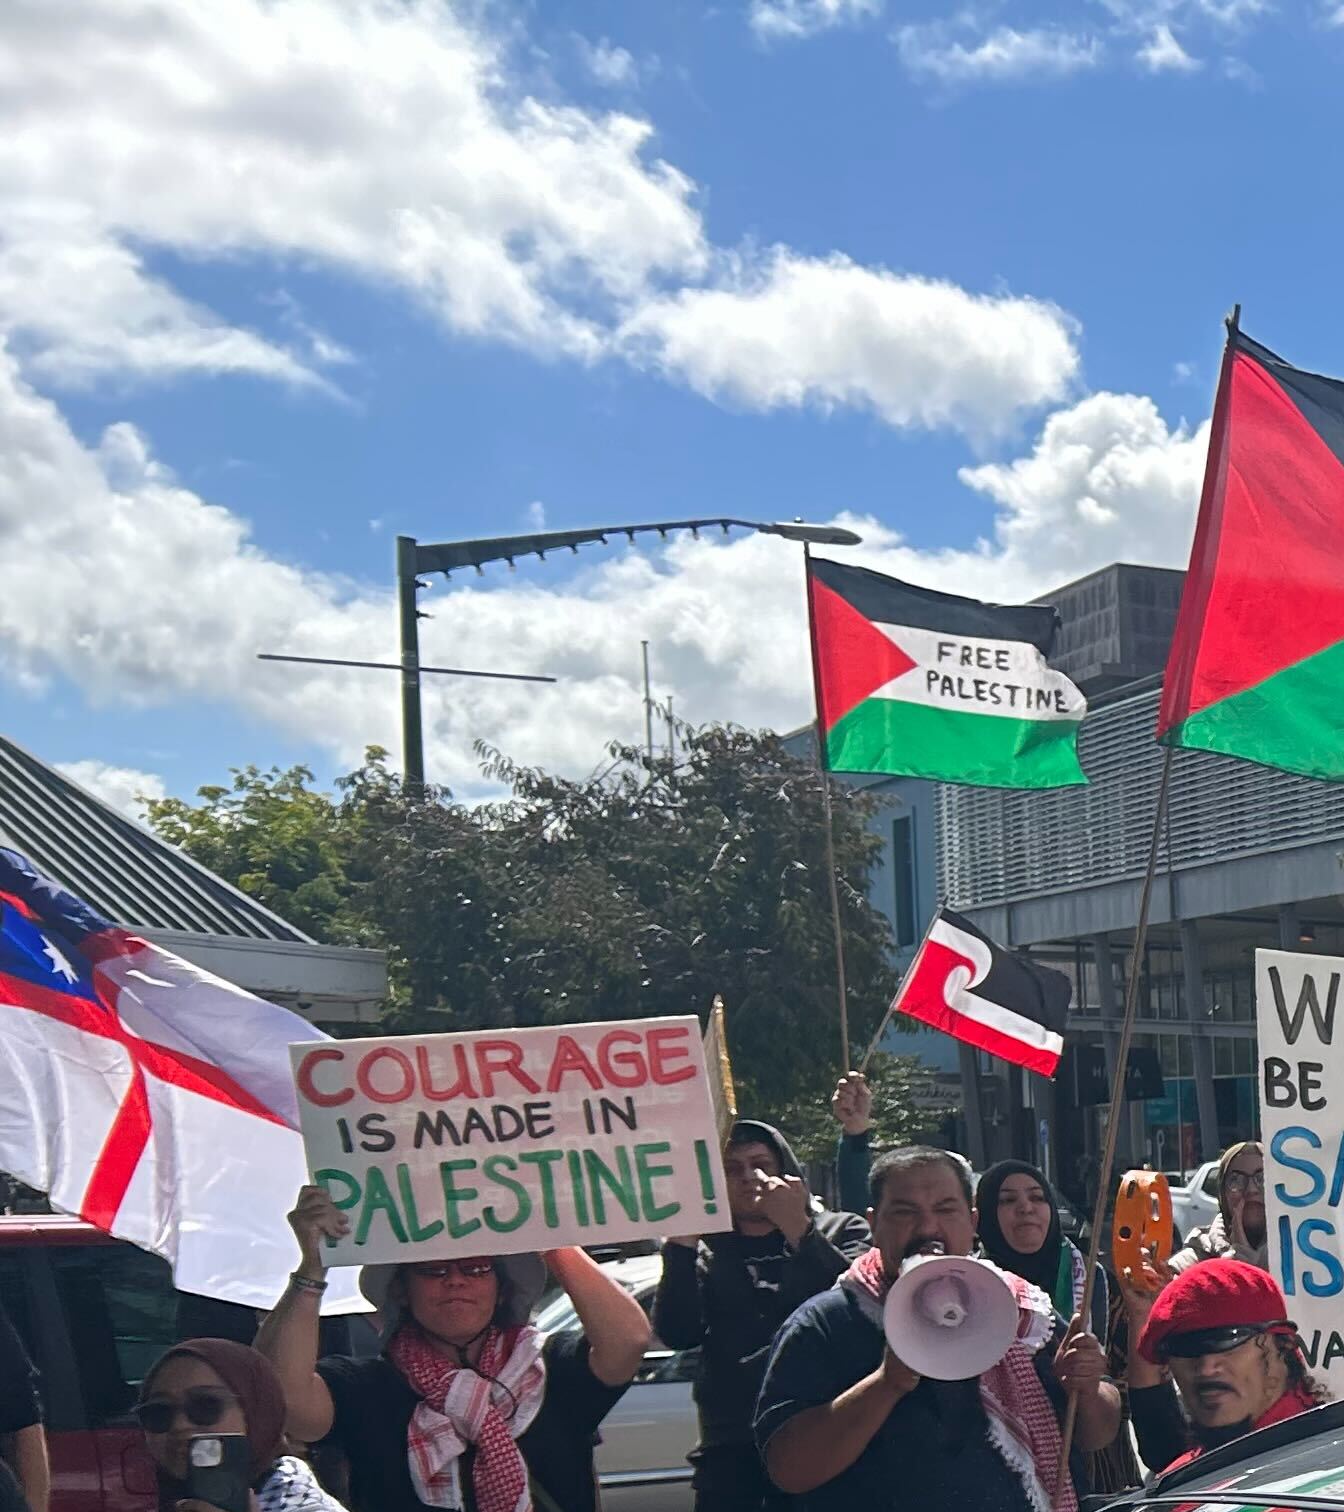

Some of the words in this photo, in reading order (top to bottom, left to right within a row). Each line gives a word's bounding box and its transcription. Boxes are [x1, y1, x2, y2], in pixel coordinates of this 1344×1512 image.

[937, 641, 1011, 670] FREE
[926, 670, 1069, 713] PALESTINE
[296, 1026, 698, 1107] COURAGE
[1264, 1056, 1327, 1111] BE
[337, 1112, 397, 1154] IS
[413, 1100, 556, 1148] MADE
[584, 1095, 637, 1135] IN
